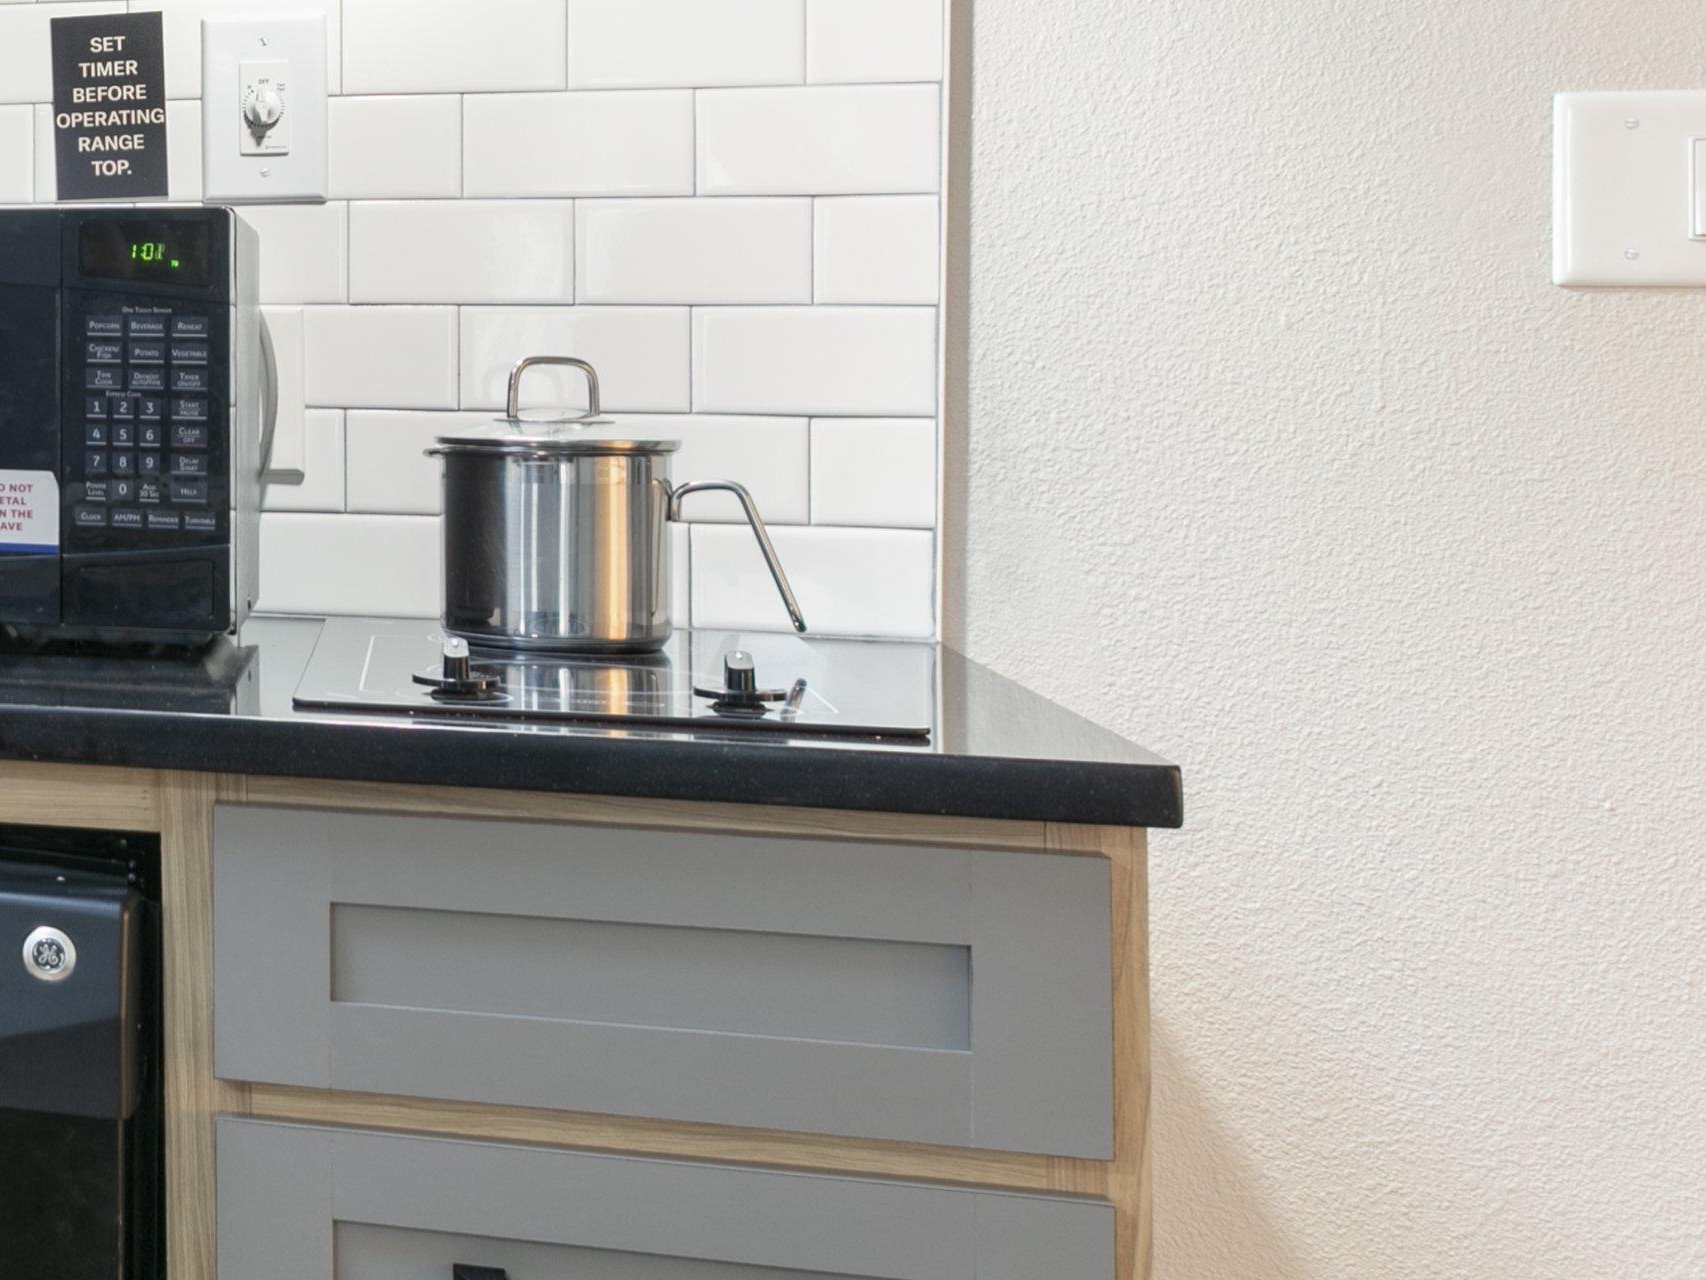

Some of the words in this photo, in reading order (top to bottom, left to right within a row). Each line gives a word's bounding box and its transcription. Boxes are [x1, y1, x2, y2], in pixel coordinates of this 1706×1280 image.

[89, 35, 125, 53] SET
[78, 60, 138, 78] TIMER
[72, 84, 147, 103] BEFORE
[56, 108, 165, 129] OPERATING
[78, 134, 145, 152] RANGE
[91, 160, 132, 177] TOP.
[93, 401, 100, 412] 1
[119, 401, 128, 413] 2
[146, 402, 154, 414] 3
[92, 428, 100, 439] 4
[119, 428, 127, 440] 5
[146, 429, 154, 440] 6
[93, 455, 101, 466] 7
[119, 456, 127, 468] 8
[146, 457, 154, 468] 9
[9, 483, 34, 493] NOT
[119, 483, 127, 495] 0
[11, 509, 34, 519] THE
[114, 513, 140, 521] AM/PM
